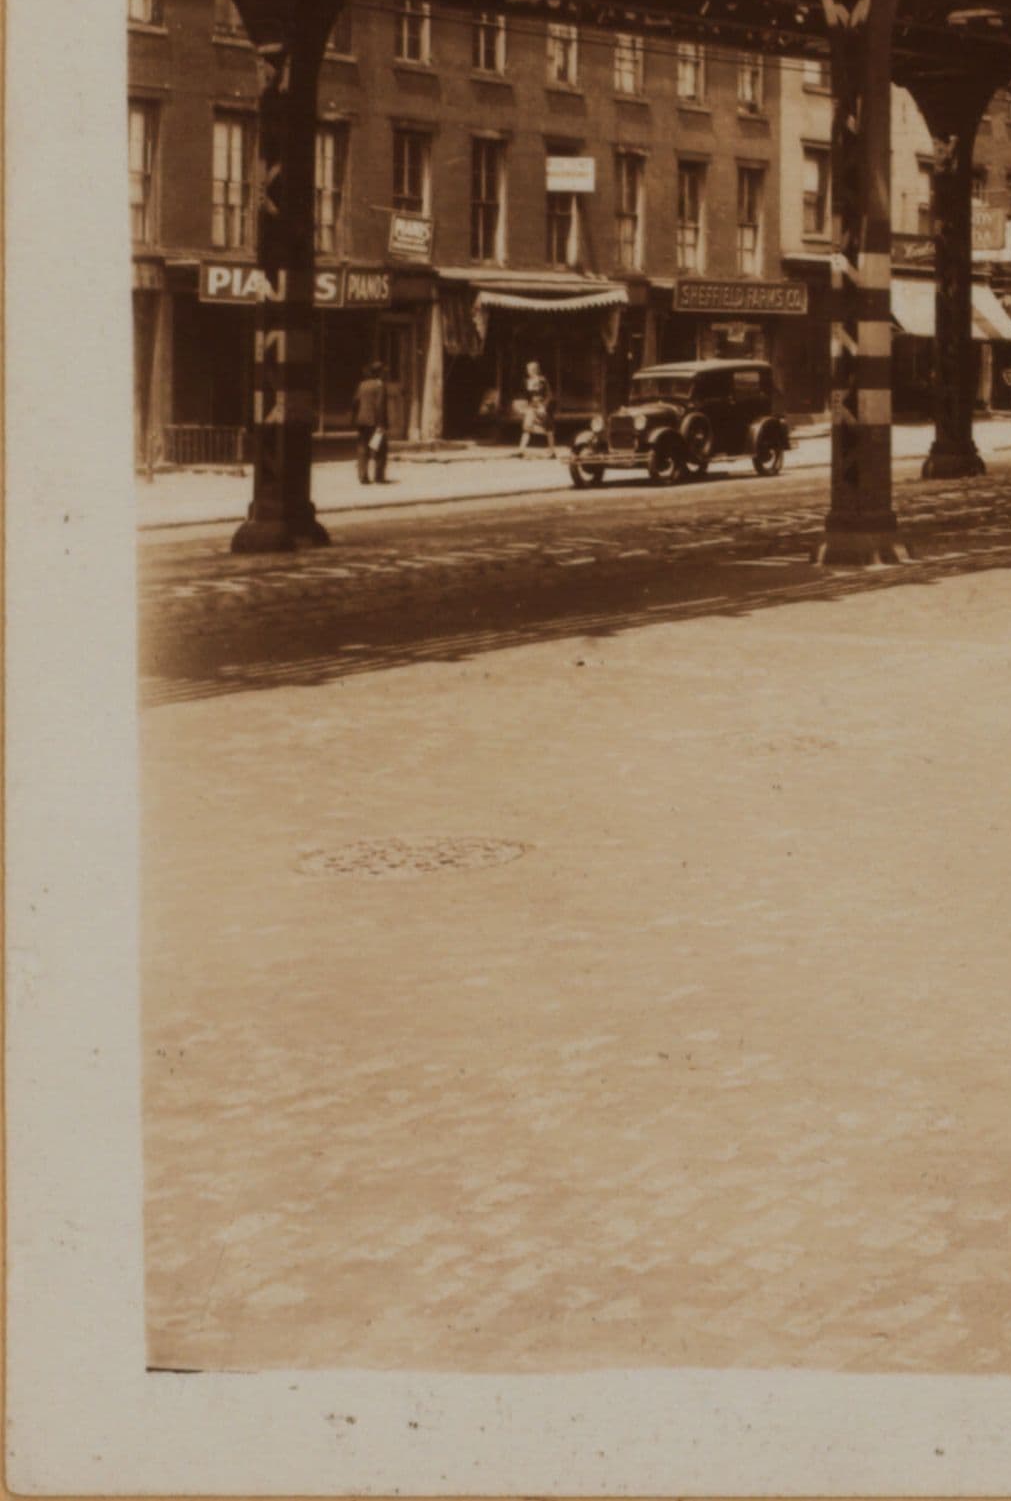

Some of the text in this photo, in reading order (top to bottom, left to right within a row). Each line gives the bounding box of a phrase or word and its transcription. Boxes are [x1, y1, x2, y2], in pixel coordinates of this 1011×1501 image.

[346, 273, 389, 302] PIANOS
[680, 284, 742, 307] SHEFFIELD
[745, 286, 782, 308] FARMS
